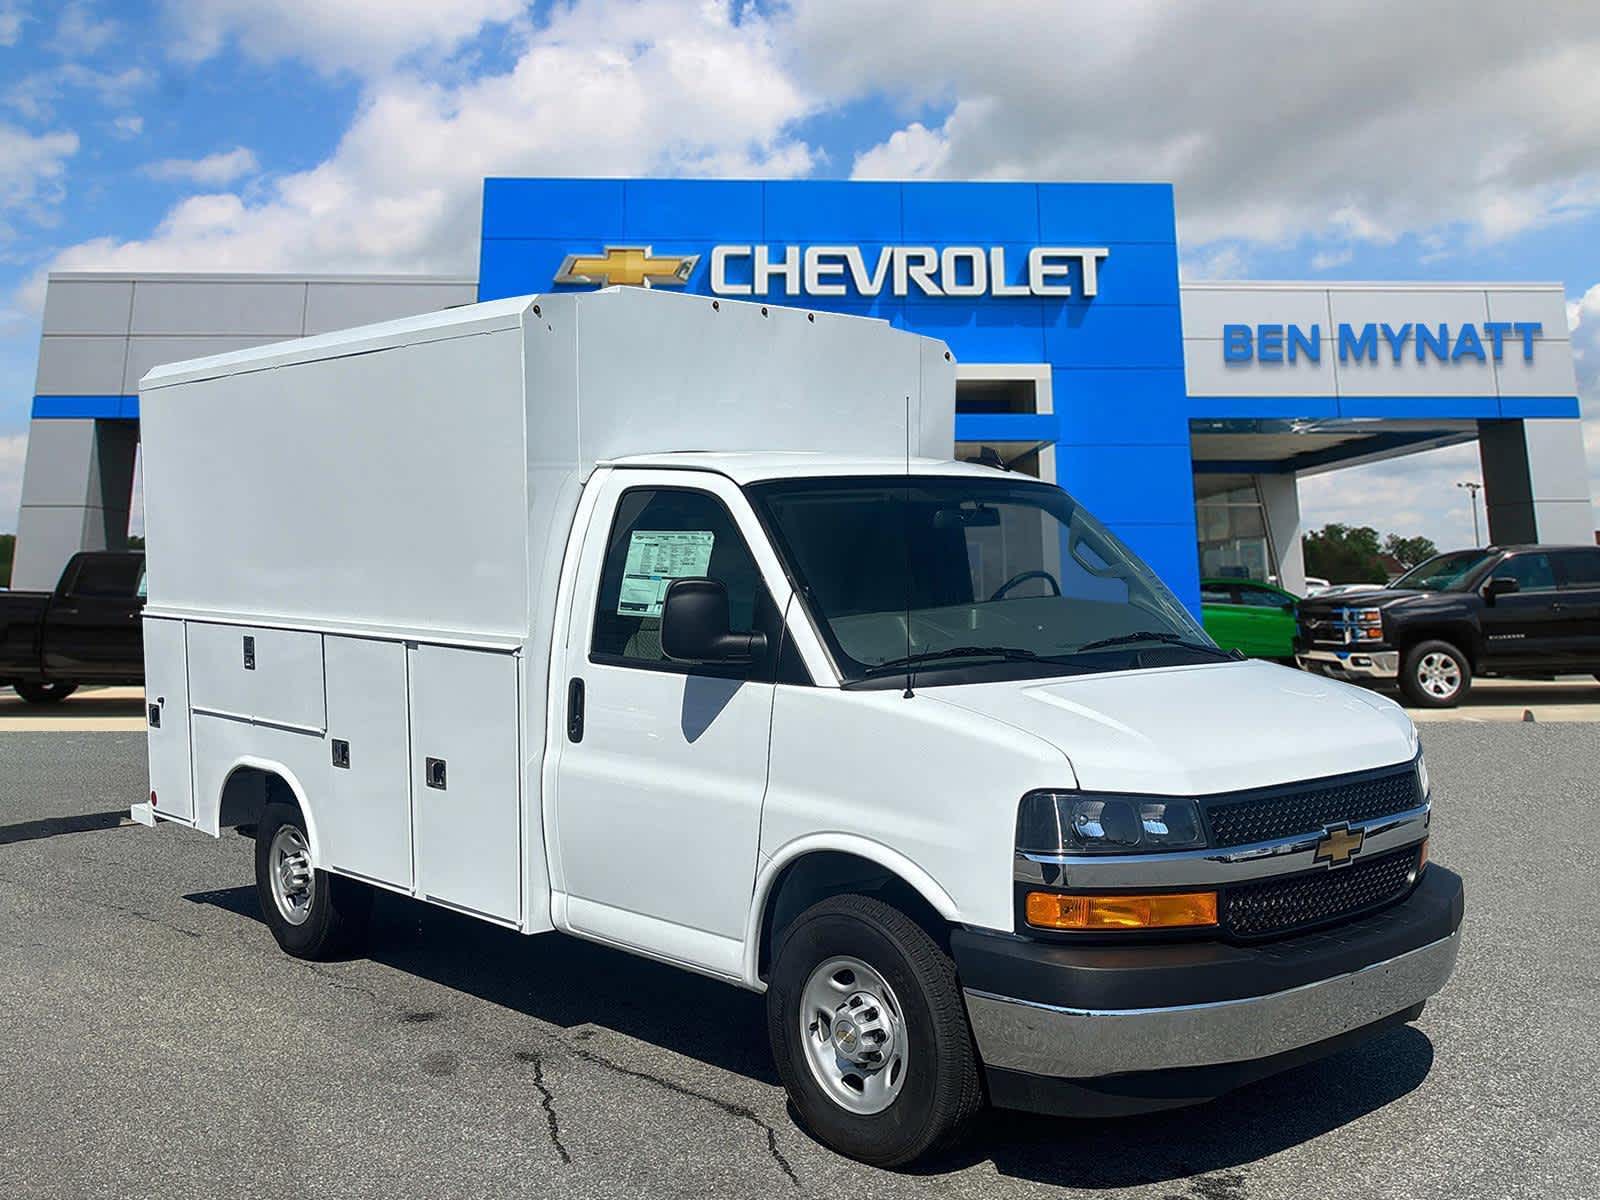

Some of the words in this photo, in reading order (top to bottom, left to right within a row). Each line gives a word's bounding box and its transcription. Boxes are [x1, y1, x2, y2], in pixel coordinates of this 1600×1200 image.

[710, 245, 1110, 297] CHEVROLET
[1223, 323, 1321, 363] BEN
[1338, 322, 1543, 362] MYNATT
